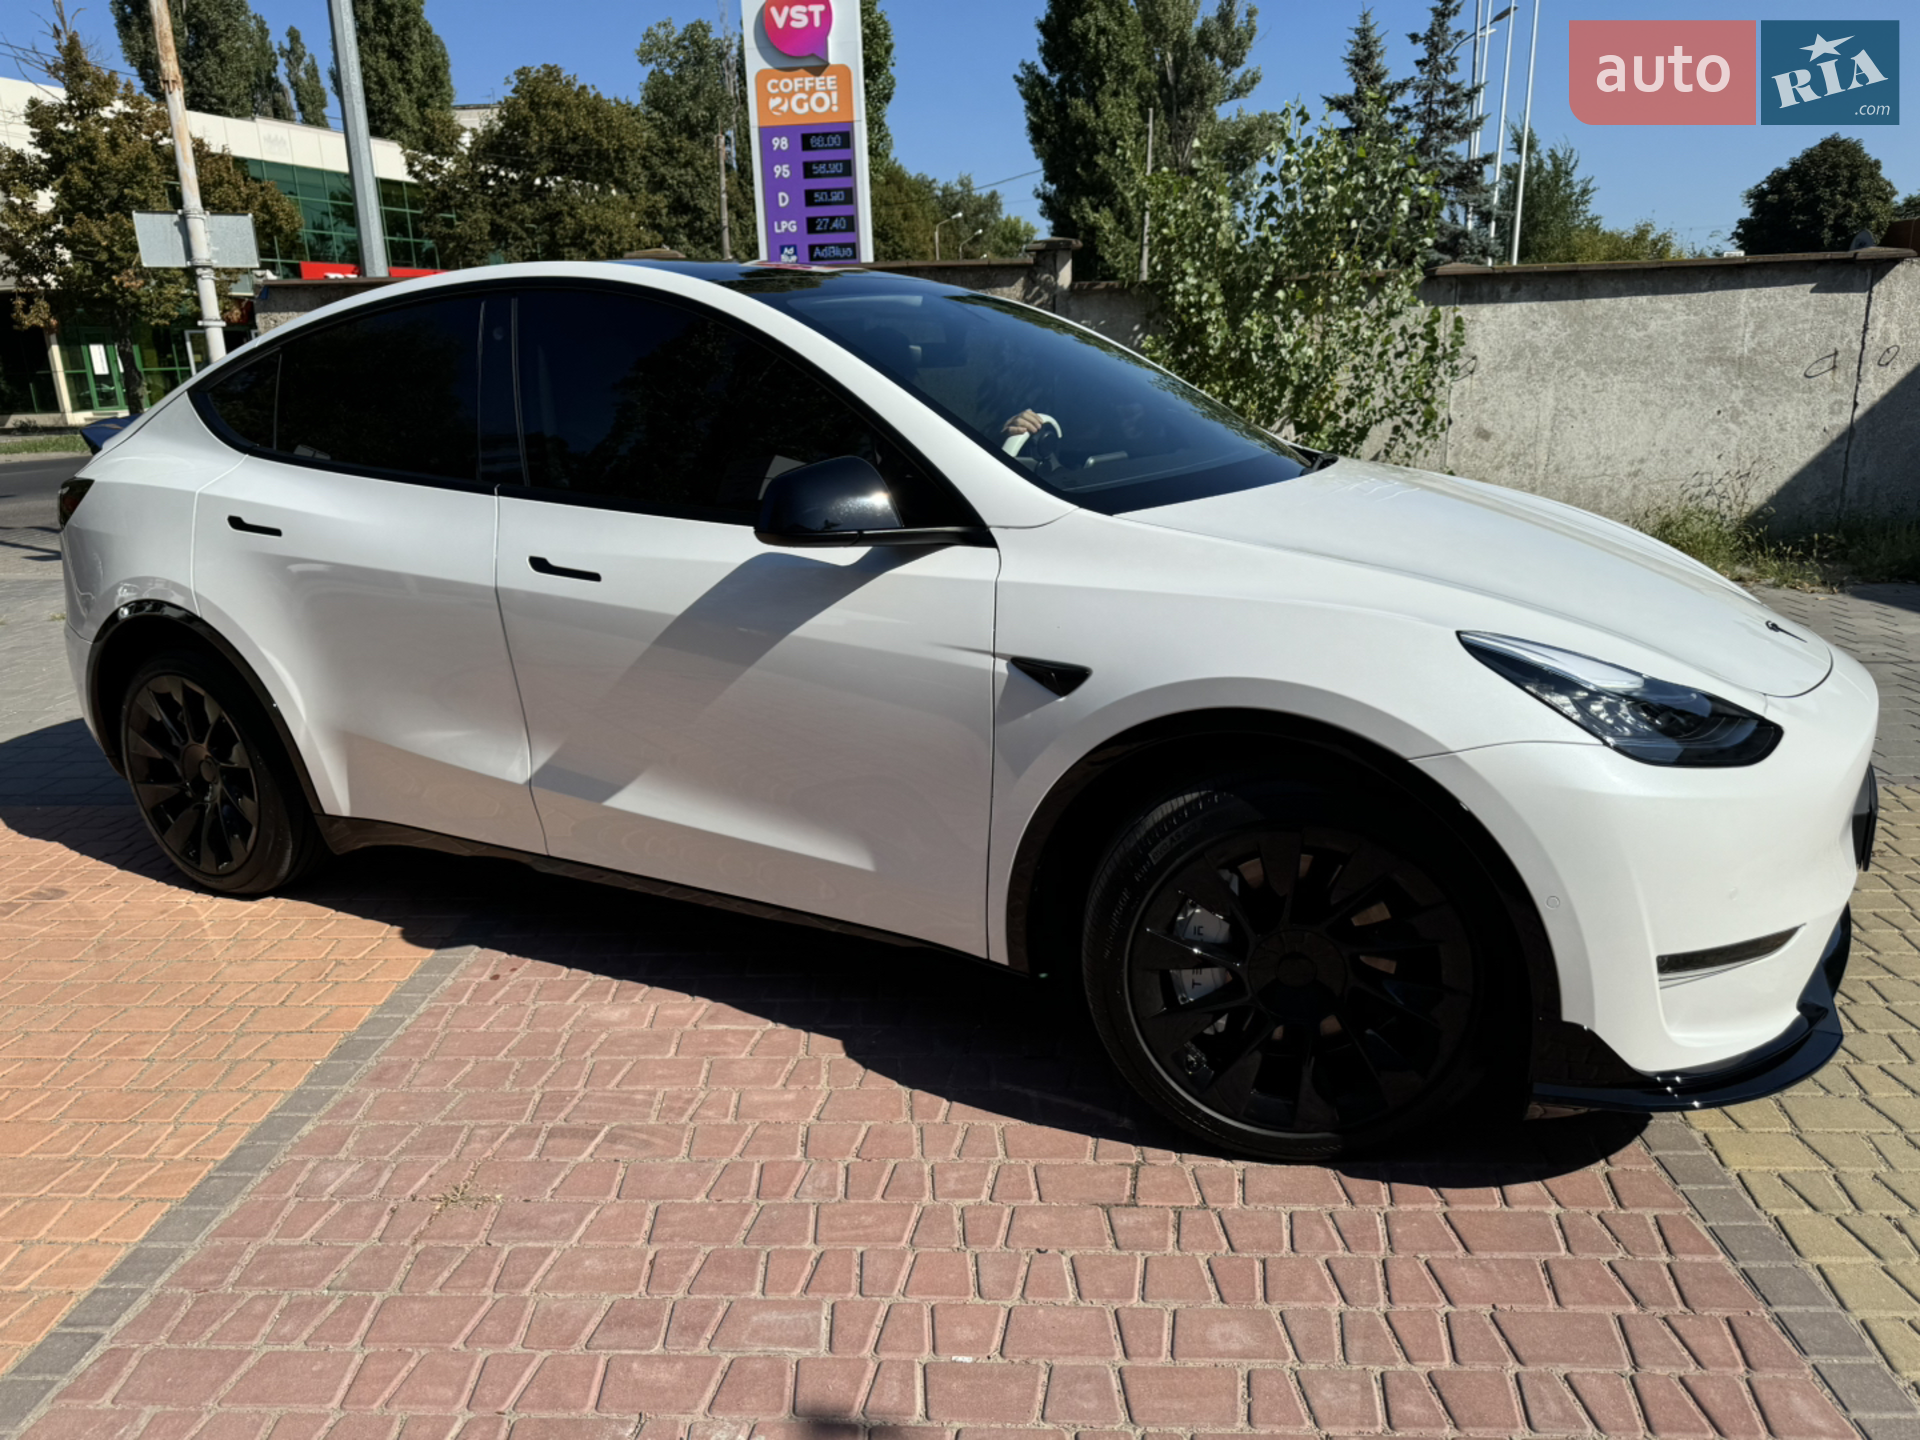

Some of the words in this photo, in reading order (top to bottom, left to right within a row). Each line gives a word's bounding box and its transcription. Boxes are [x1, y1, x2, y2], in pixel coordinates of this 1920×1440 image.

[770, 4, 826, 29] VST
[767, 76, 838, 93] COFFEE
[771, 136, 789, 151] 98
[773, 164, 791, 179] 95
[778, 192, 789, 208] D
[774, 220, 797, 234] LPG
[815, 217, 847, 231] 27.40
